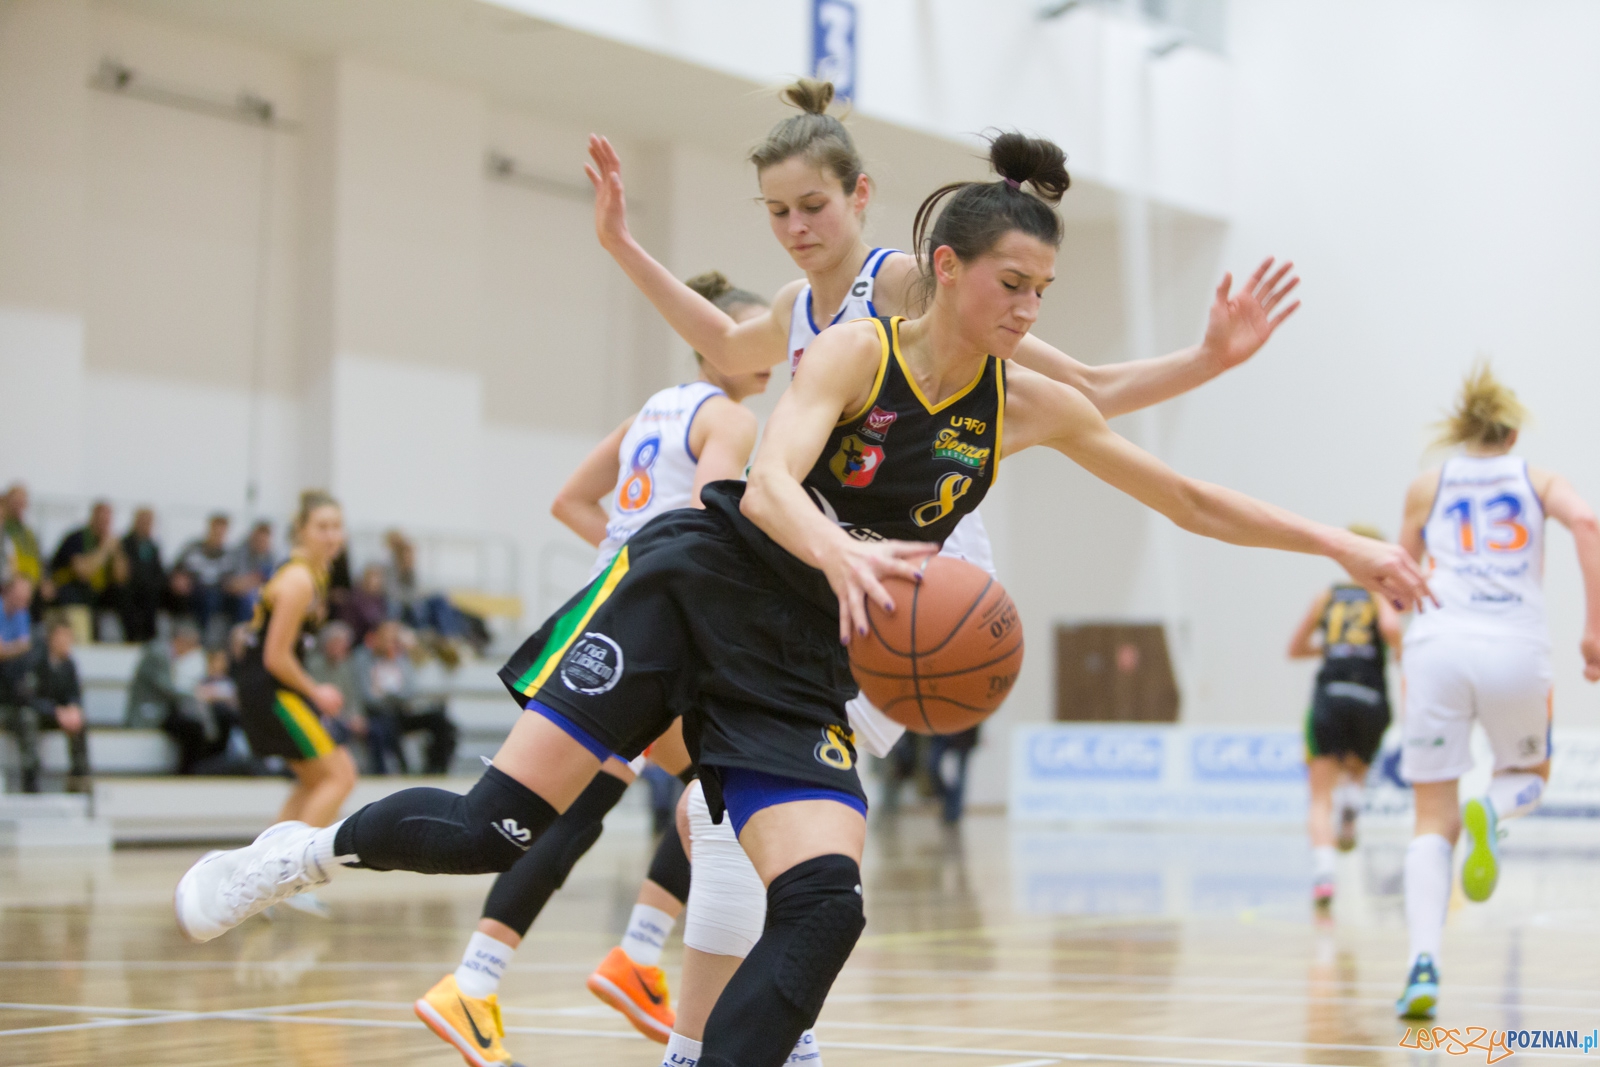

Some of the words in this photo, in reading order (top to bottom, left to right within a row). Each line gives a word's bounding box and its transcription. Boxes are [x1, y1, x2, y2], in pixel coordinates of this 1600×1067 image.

[851, 281, 869, 298] C
[616, 434, 661, 512] 8
[910, 472, 972, 527] 8
[1444, 492, 1530, 553] 13
[1328, 601, 1373, 644] 12
